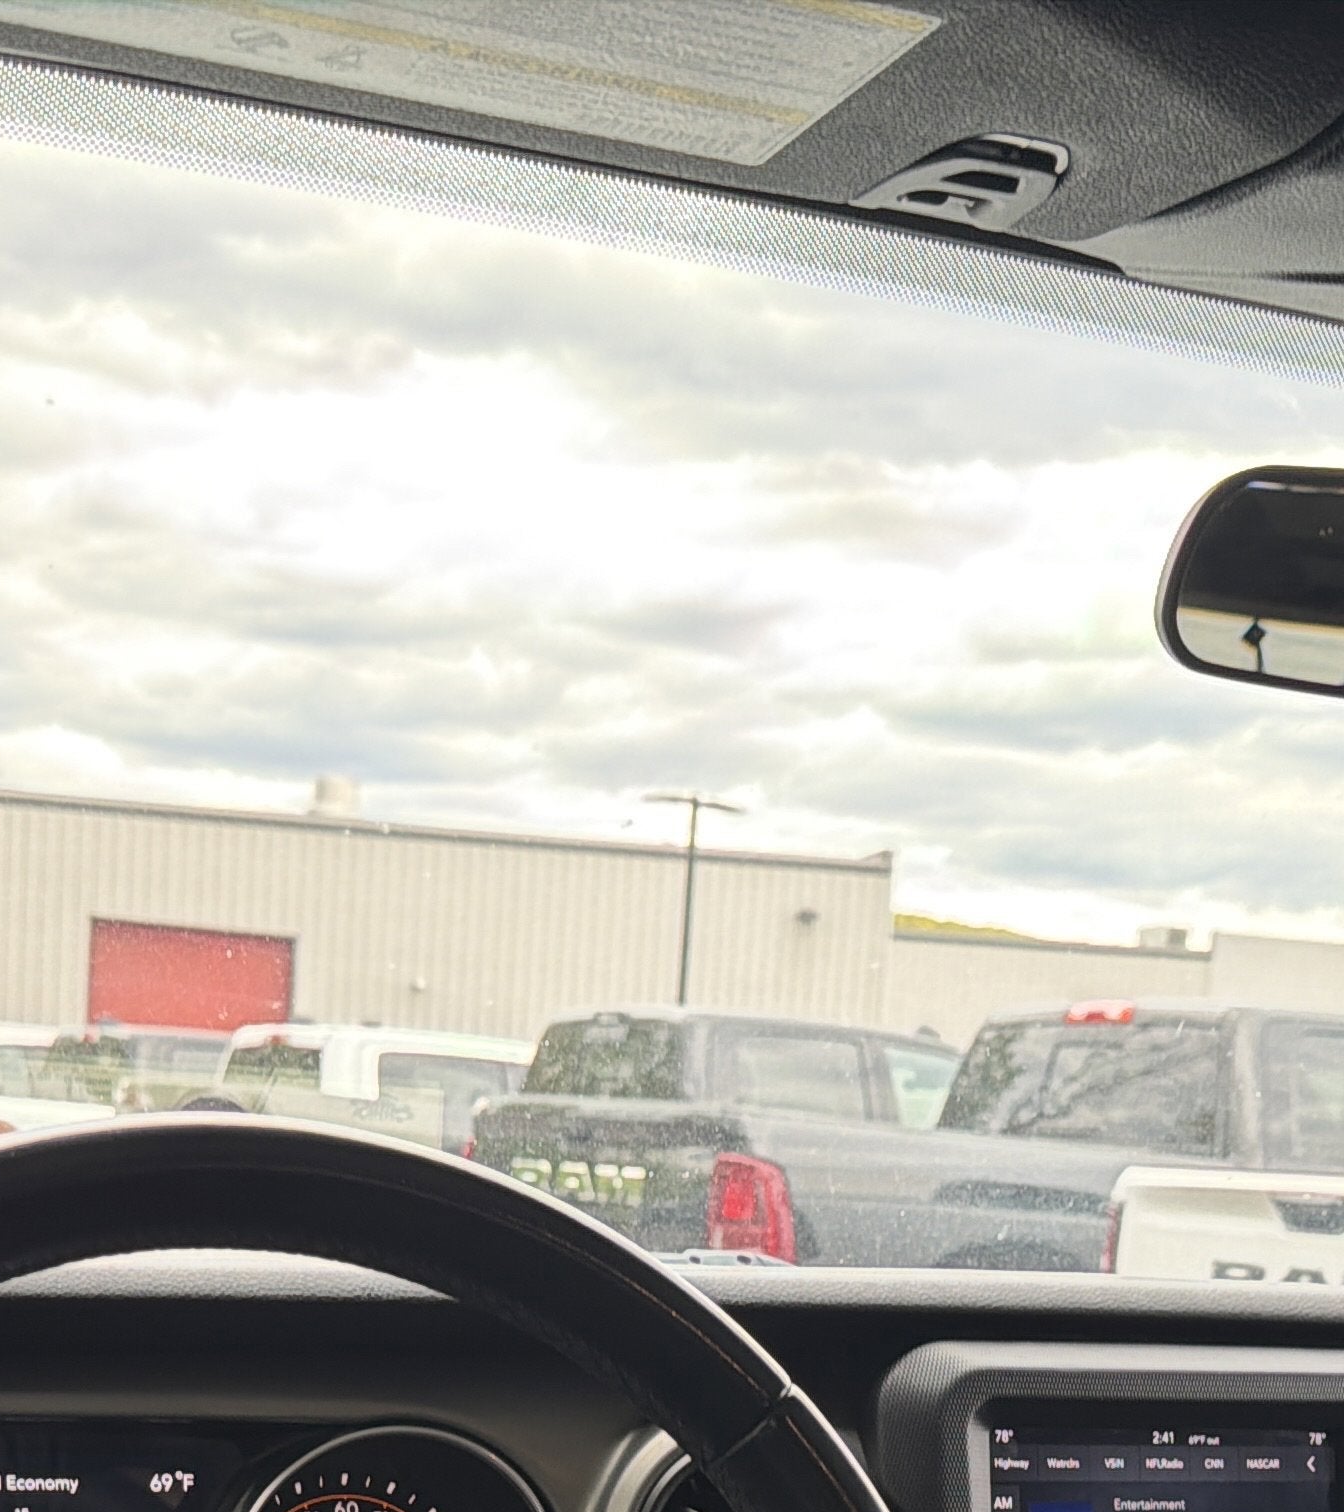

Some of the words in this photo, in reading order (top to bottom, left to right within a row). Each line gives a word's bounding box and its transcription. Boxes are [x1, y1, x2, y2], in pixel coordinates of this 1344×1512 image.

[1152, 1431, 1175, 1446] 2:41
[994, 1457, 1030, 1471] Highway
[1246, 1458, 1281, 1470] NASCAR
[6, 1474, 79, 1495] Economy
[993, 1495, 1013, 1510] AM
[1114, 1498, 1185, 1512] Entertainment
